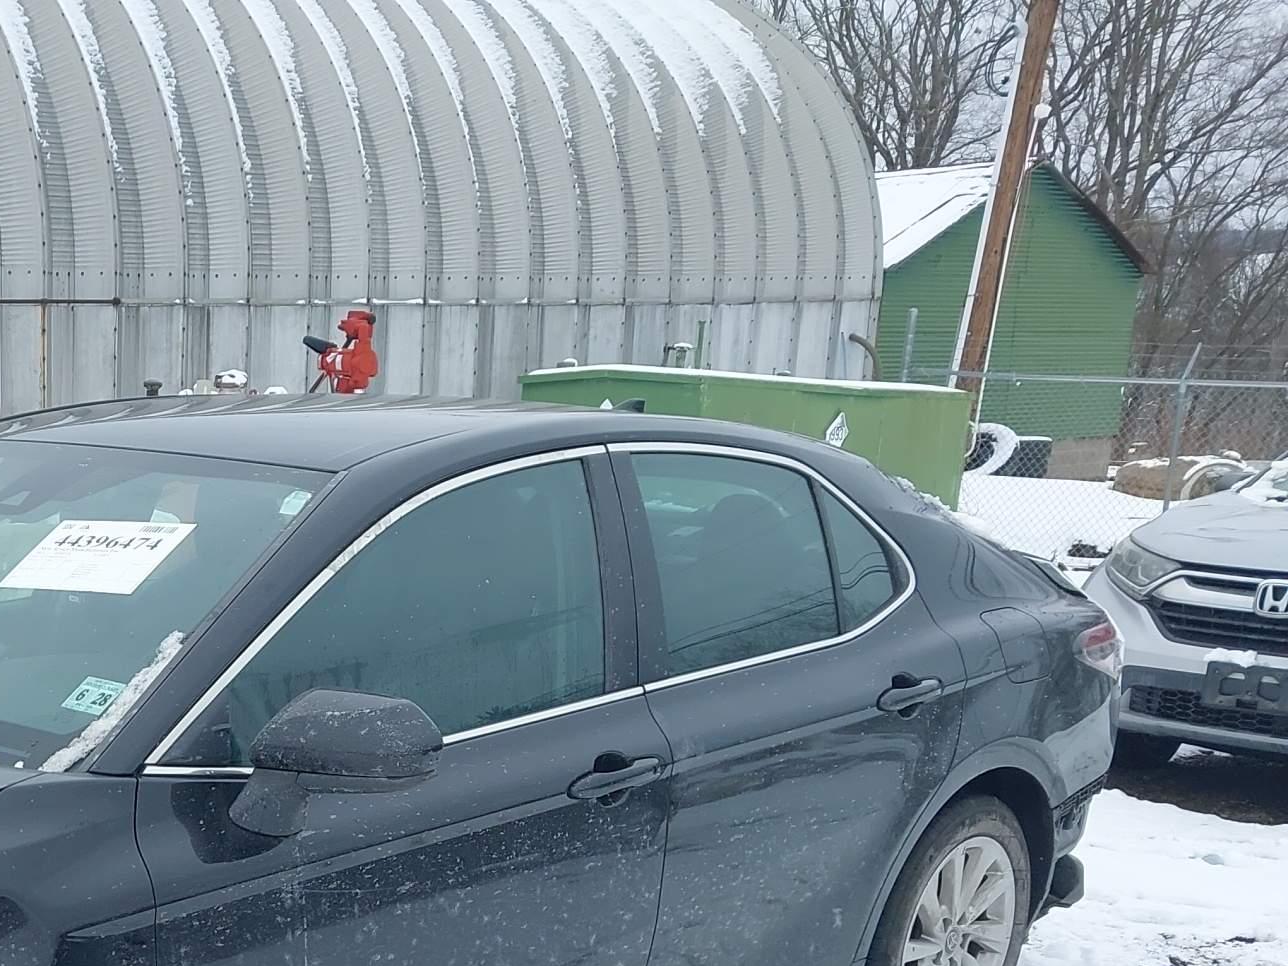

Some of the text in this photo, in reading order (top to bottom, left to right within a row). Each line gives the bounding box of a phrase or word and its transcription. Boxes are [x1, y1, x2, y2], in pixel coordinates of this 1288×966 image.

[54, 534, 163, 551] 44396474
[75, 688, 90, 702] 6
[89, 692, 112, 707] 28
